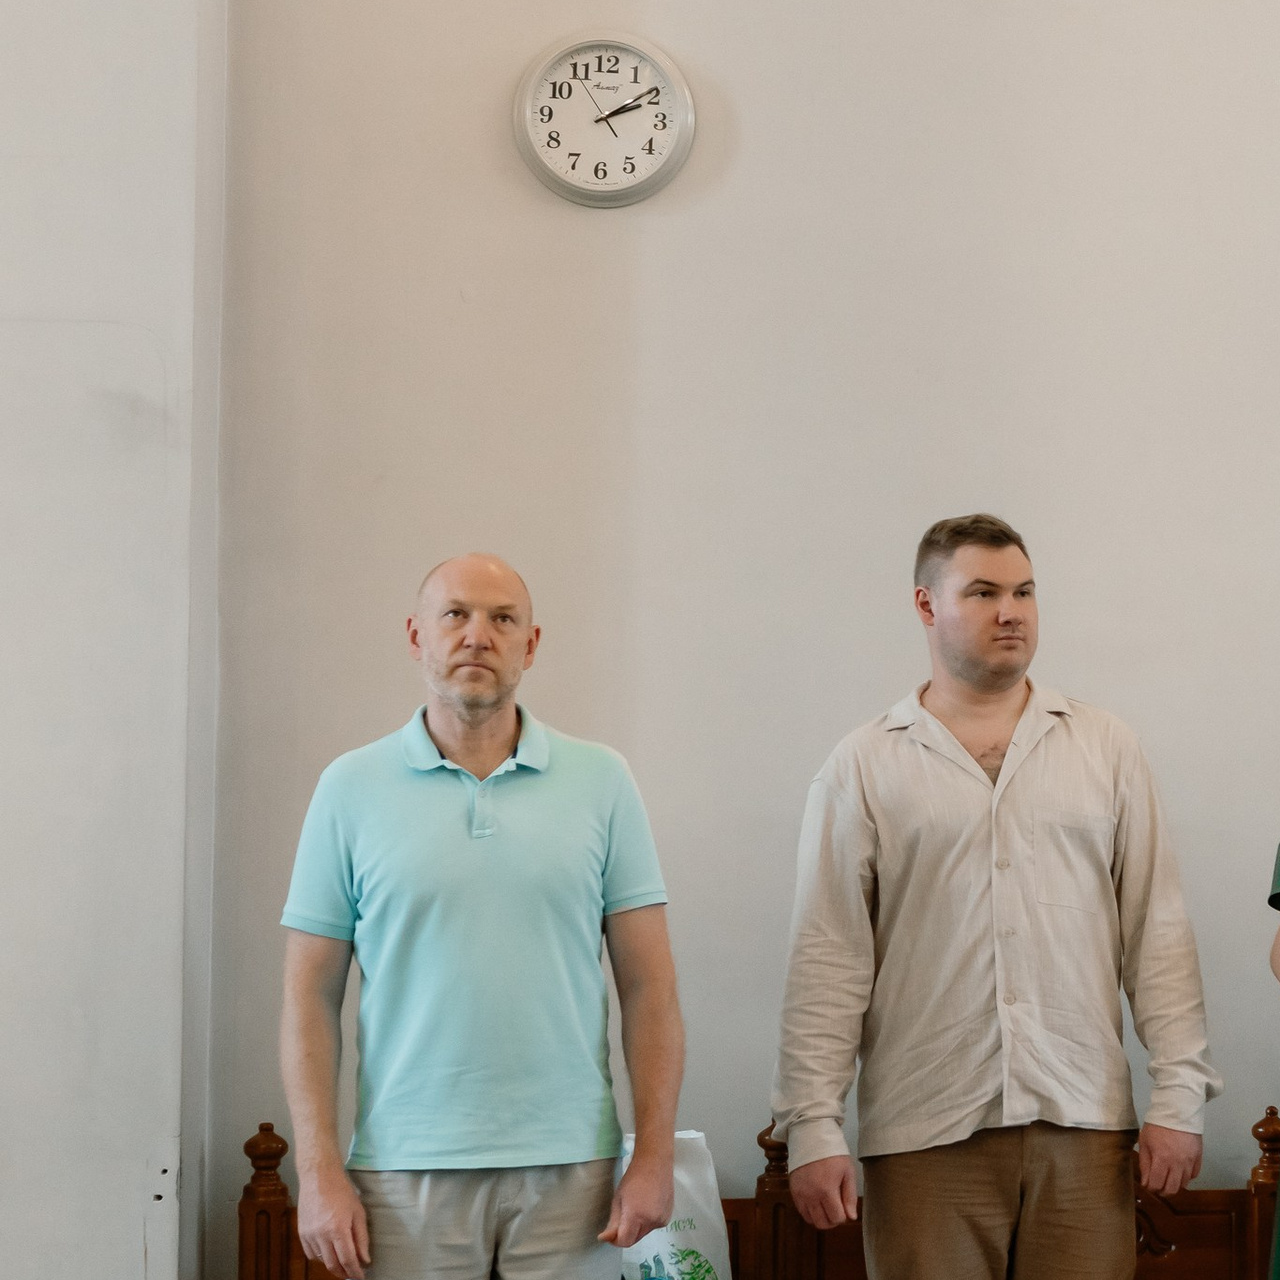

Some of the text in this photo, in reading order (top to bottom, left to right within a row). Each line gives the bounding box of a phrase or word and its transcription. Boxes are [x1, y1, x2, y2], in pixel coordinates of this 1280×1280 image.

[569, 62, 592, 81] 11
[594, 55, 620, 74] 12
[629, 66, 641, 84] 1
[549, 81, 573, 100] 10
[647, 87, 660, 106] 2
[539, 105, 553, 124] 9
[653, 112, 667, 131] 3
[546, 131, 561, 149] 8
[641, 137, 655, 155] 4
[568, 153, 581, 171] 7
[593, 161, 608, 180] 6
[622, 156, 636, 174] 5
